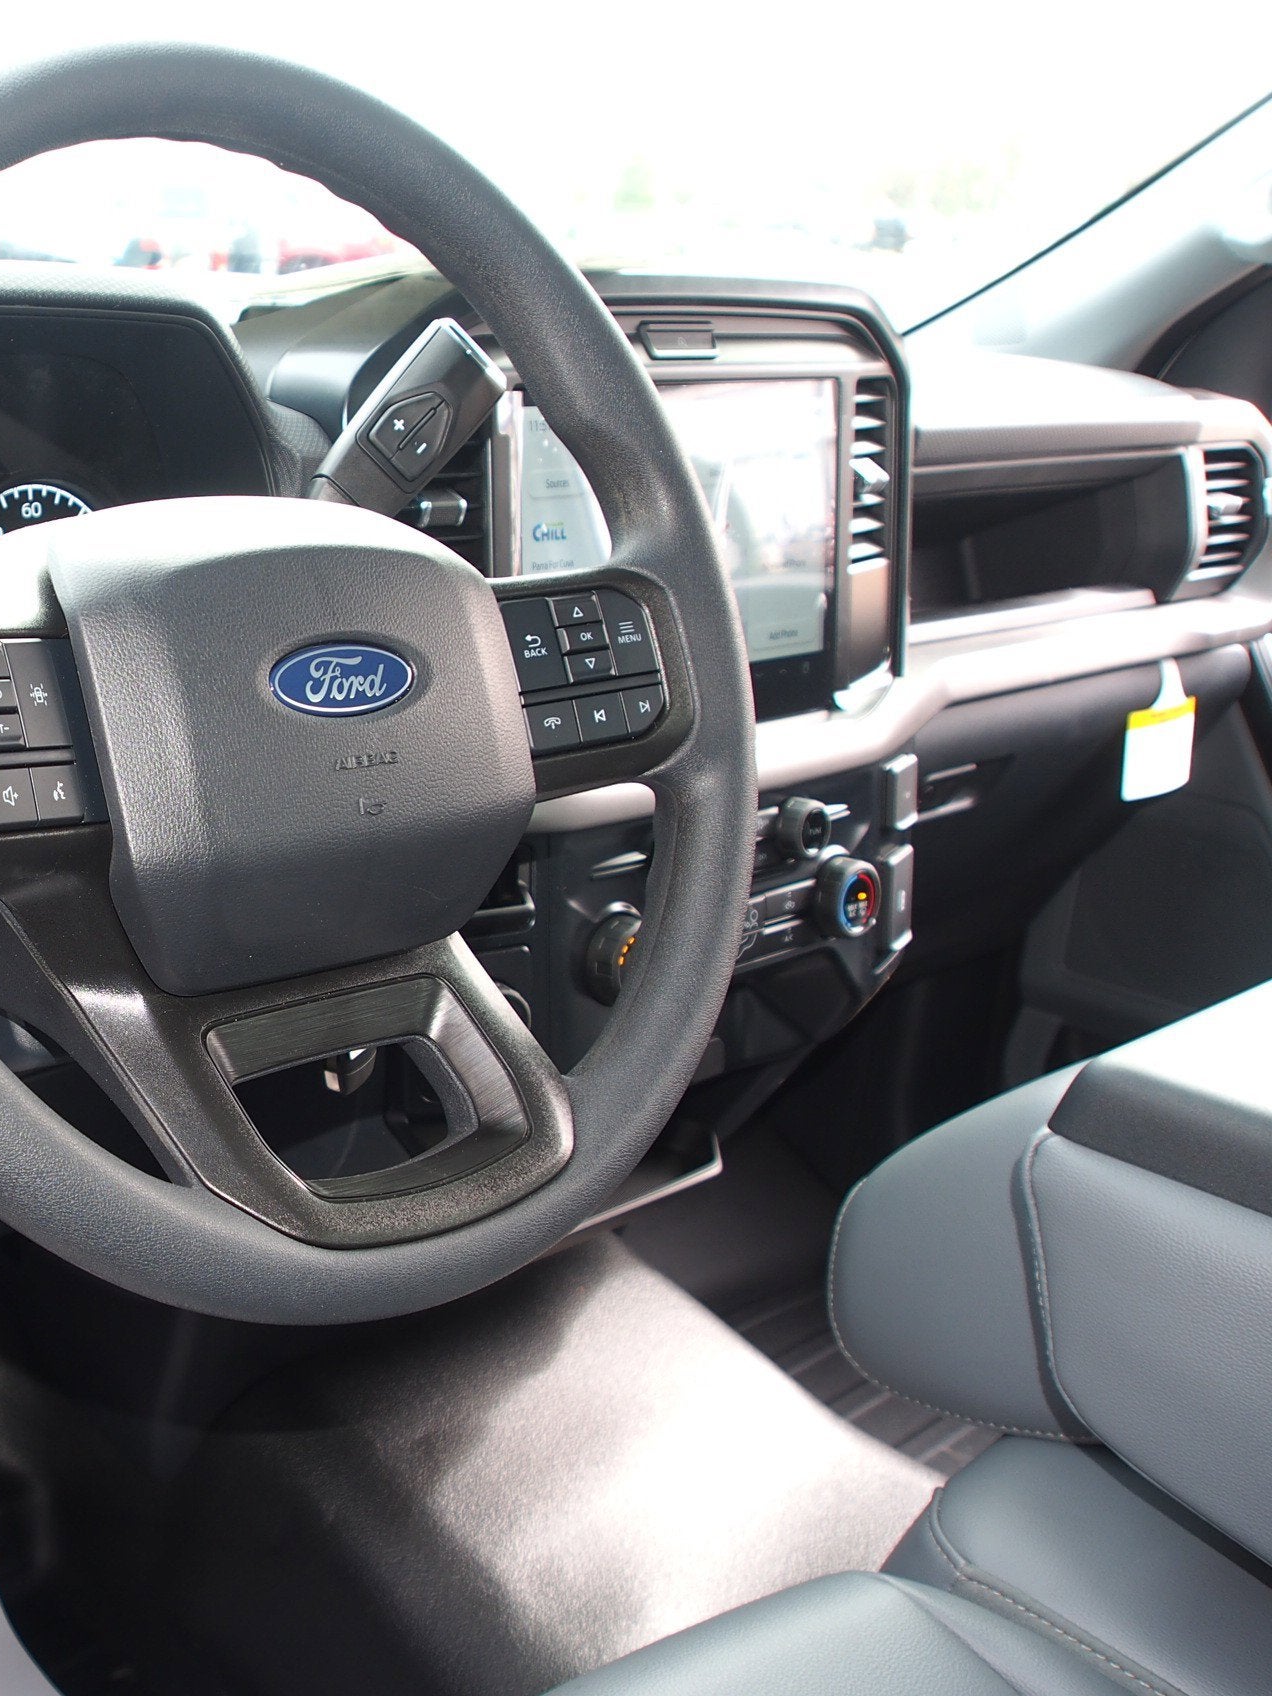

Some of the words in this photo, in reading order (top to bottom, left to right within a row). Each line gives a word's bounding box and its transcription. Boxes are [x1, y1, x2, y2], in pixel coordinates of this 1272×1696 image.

[21, 501, 43, 519] 60
[580, 631, 594, 641] OK
[617, 633, 642, 645] MENU
[524, 647, 549, 658] BACK
[305, 655, 387, 703] Ford
[335, 751, 399, 771] AIRBAG
